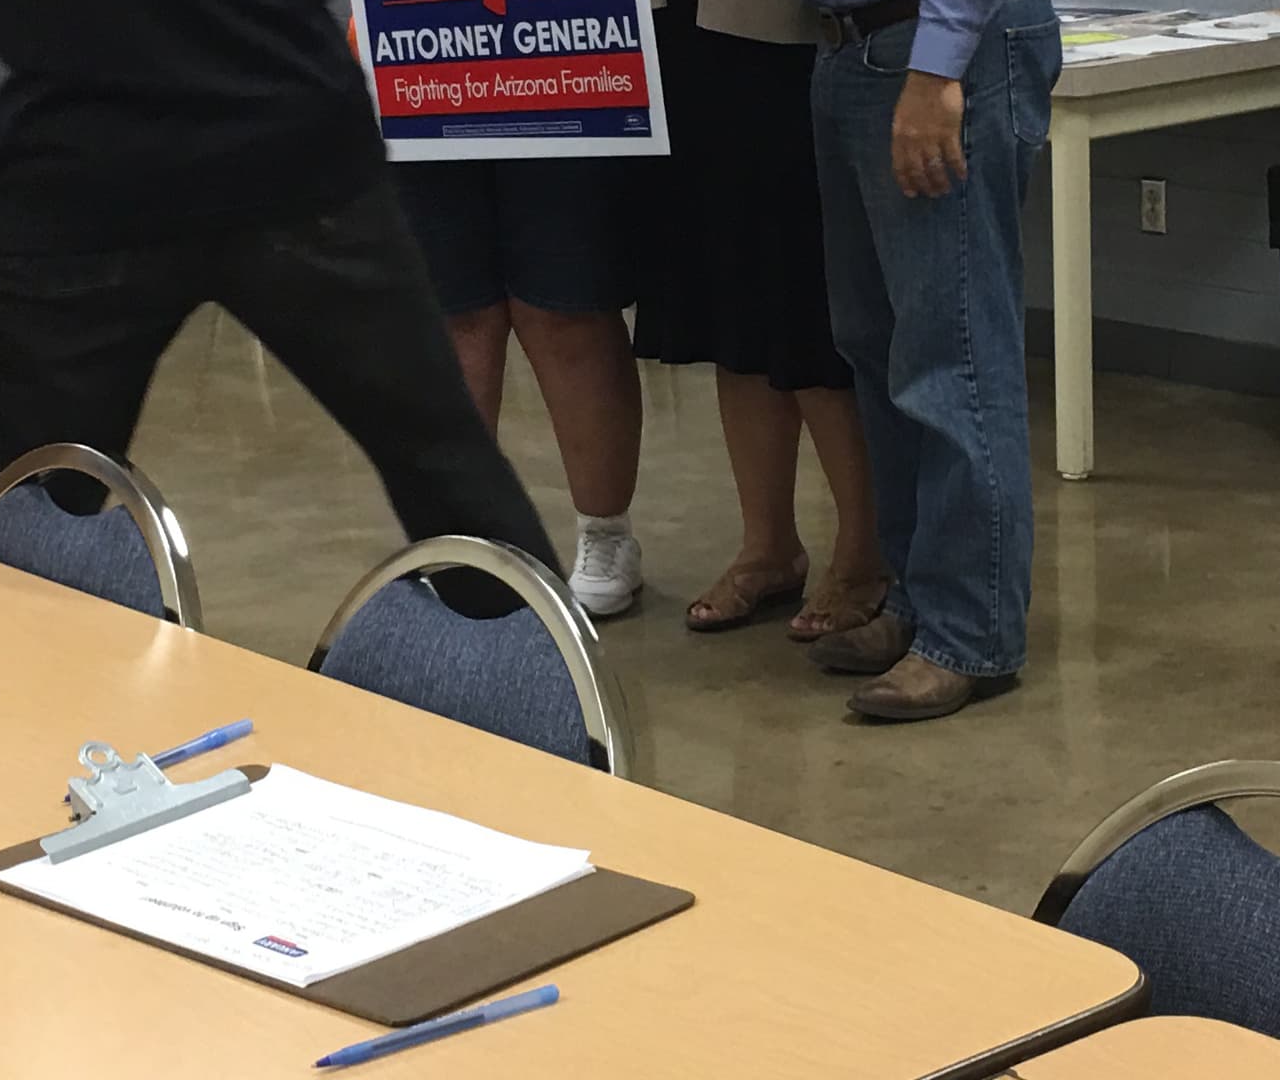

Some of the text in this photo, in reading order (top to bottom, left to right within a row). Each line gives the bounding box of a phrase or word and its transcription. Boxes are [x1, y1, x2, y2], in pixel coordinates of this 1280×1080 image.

[376, 16, 638, 62] ATTORNEY GENERAL
[395, 66, 633, 108] Fighting for Arizona Families
